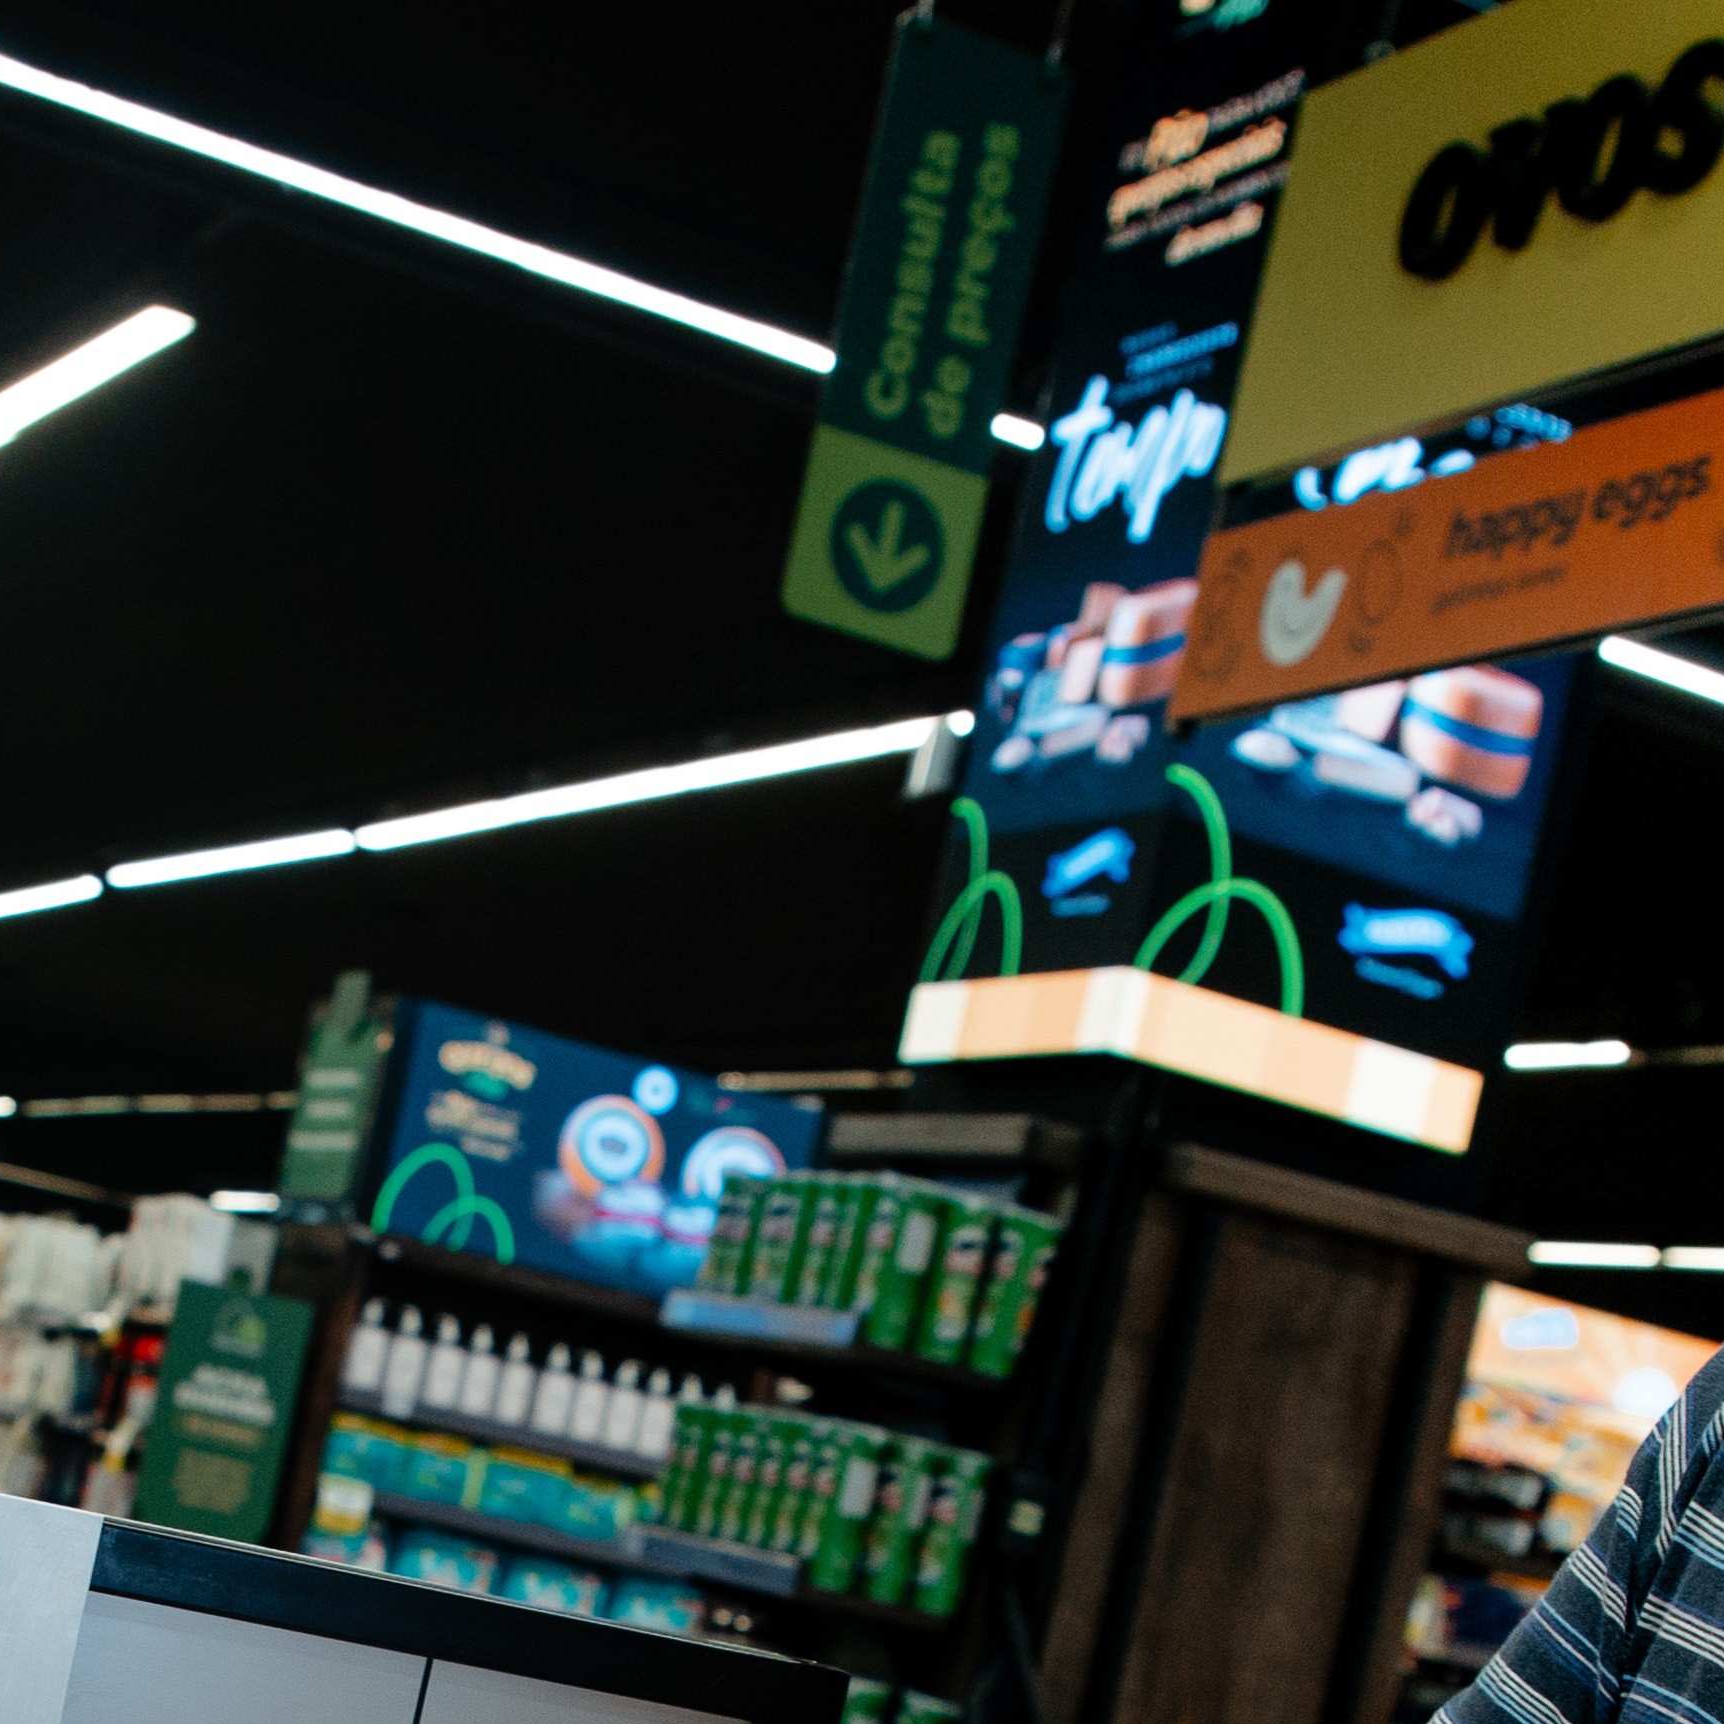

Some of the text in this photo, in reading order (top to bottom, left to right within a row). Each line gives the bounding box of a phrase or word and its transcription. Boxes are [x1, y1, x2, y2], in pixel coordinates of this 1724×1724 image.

[864, 128, 962, 421] Consulta
[921, 355, 970, 440] de
[1443, 453, 1713, 560] happy eggs
